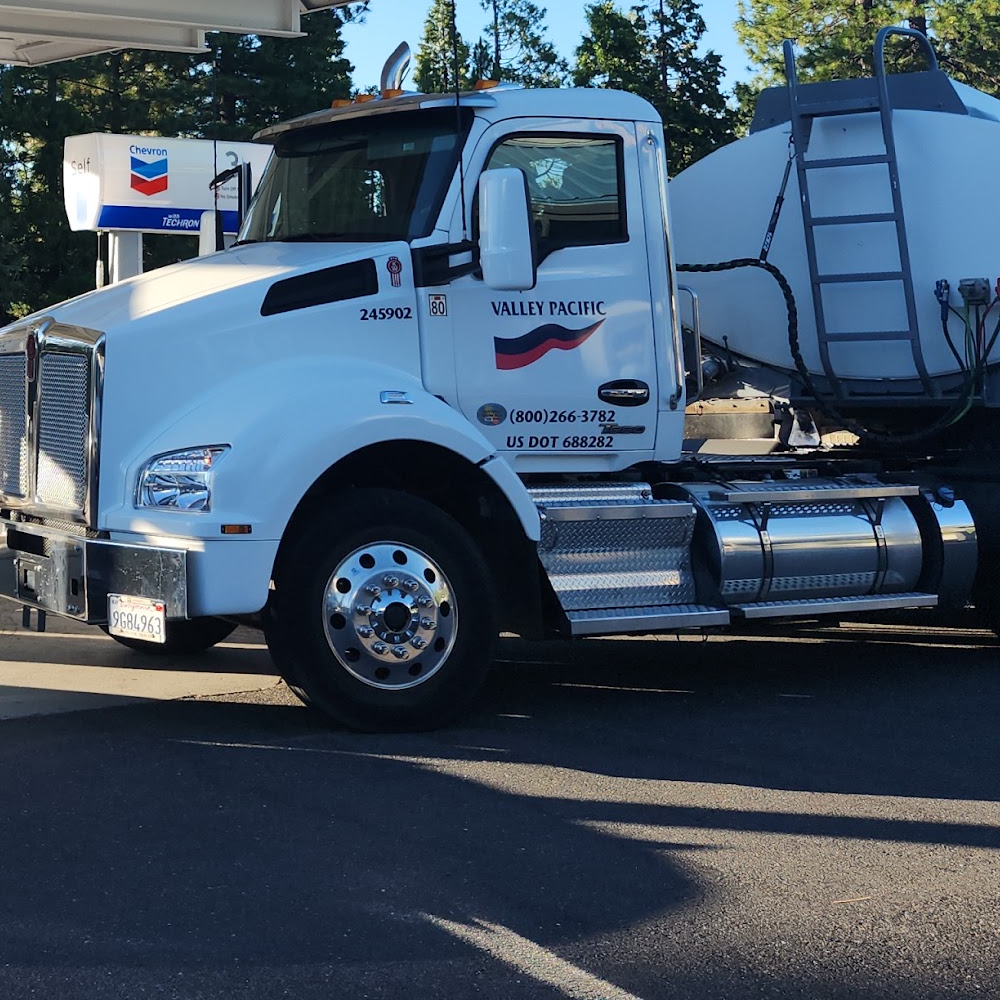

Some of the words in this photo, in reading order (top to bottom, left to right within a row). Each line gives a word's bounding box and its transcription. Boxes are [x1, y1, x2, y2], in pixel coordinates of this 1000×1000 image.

[129, 144, 168, 156] Chevron
[71, 157, 91, 176] Self
[162, 217, 200, 229] TECHRON
[359, 307, 412, 321] 245902
[431, 301, 445, 315] 80
[491, 301, 544, 316] VALLEY
[549, 301, 607, 316] PACIFIC
[509, 409, 616, 425] (800)266-3782
[506, 436, 524, 448] US
[528, 436, 559, 448] DOT
[562, 436, 614, 448] 688282
[112, 610, 161, 635] 9G84963
